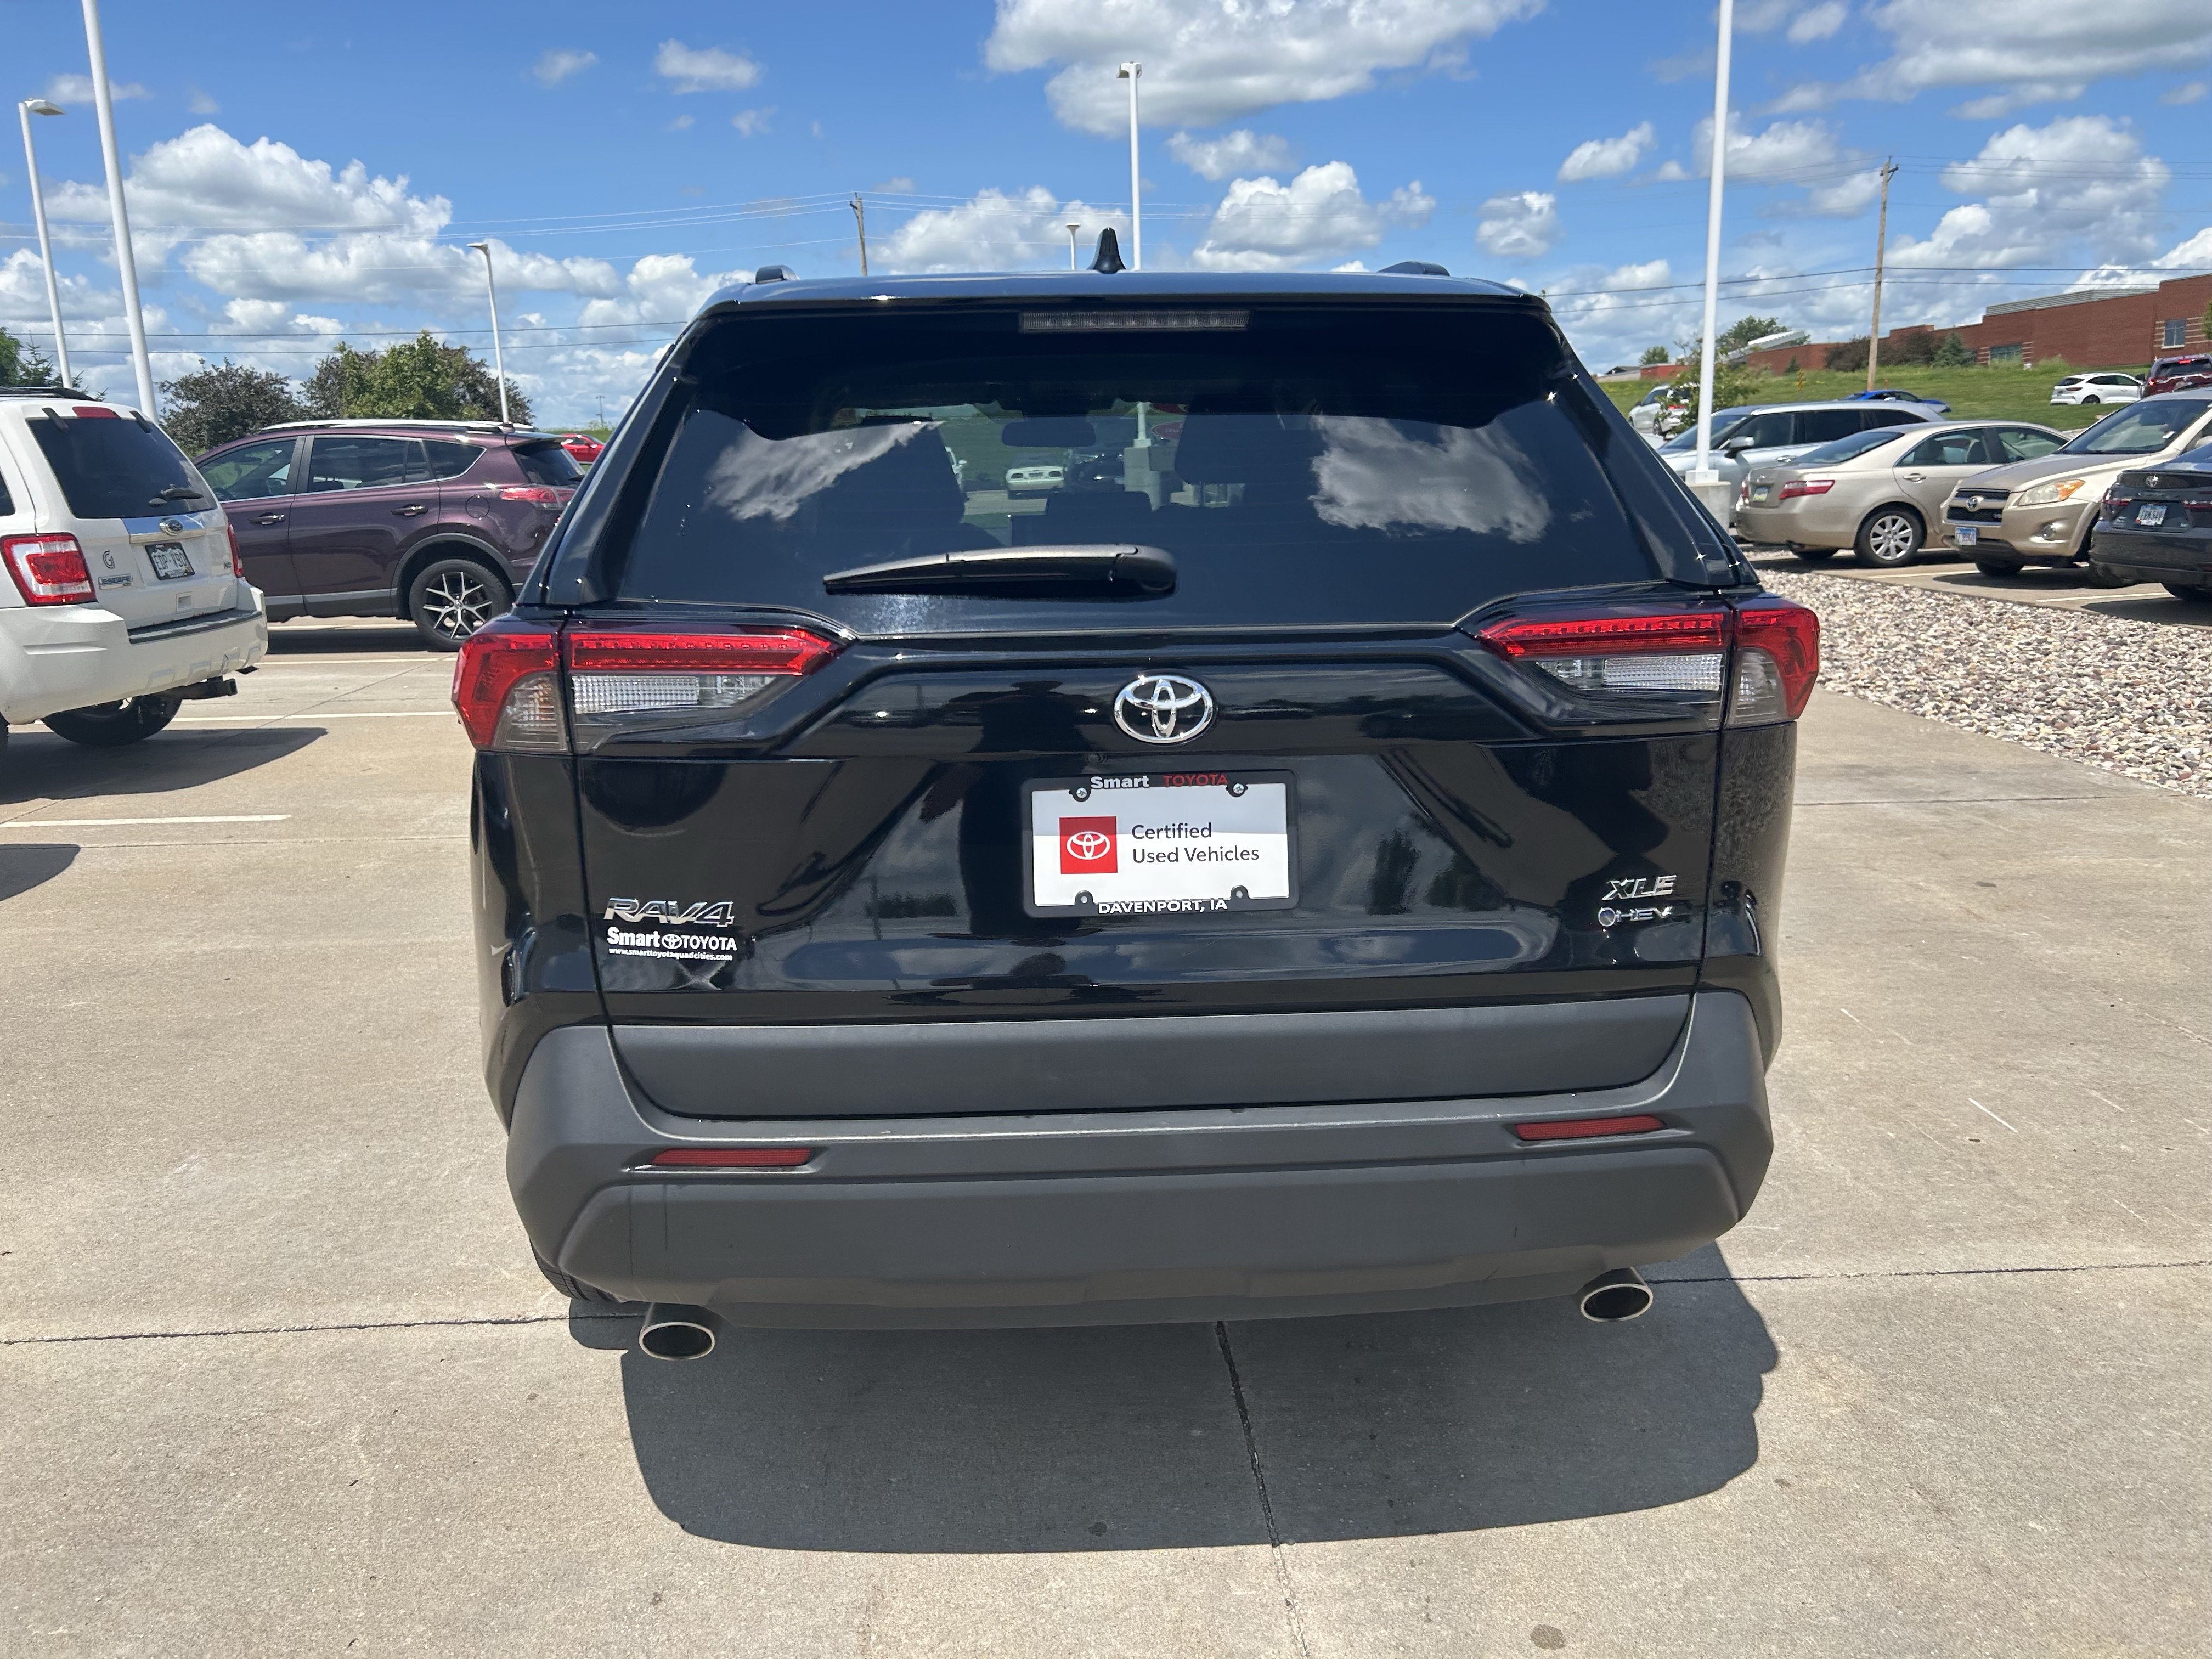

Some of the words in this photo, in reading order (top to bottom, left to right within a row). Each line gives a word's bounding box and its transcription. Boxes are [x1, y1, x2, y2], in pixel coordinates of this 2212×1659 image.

[1090, 775, 1149, 789] Smart
[1163, 774, 1228, 787] TOYOTA
[1131, 822, 1212, 839] Certified
[1133, 847, 1178, 864] Used
[1184, 845, 1260, 862] Vehicles
[1602, 875, 1677, 900] XLE
[603, 897, 735, 927] RAV4
[1098, 900, 1205, 913] DAVENPORT,
[1210, 899, 1228, 910] IA
[1616, 906, 1673, 922] HEV
[607, 926, 660, 947] Smart
[681, 935, 737, 951] TOYOTA
[608, 947, 733, 961] www.smarttoyotaquadcities.com
